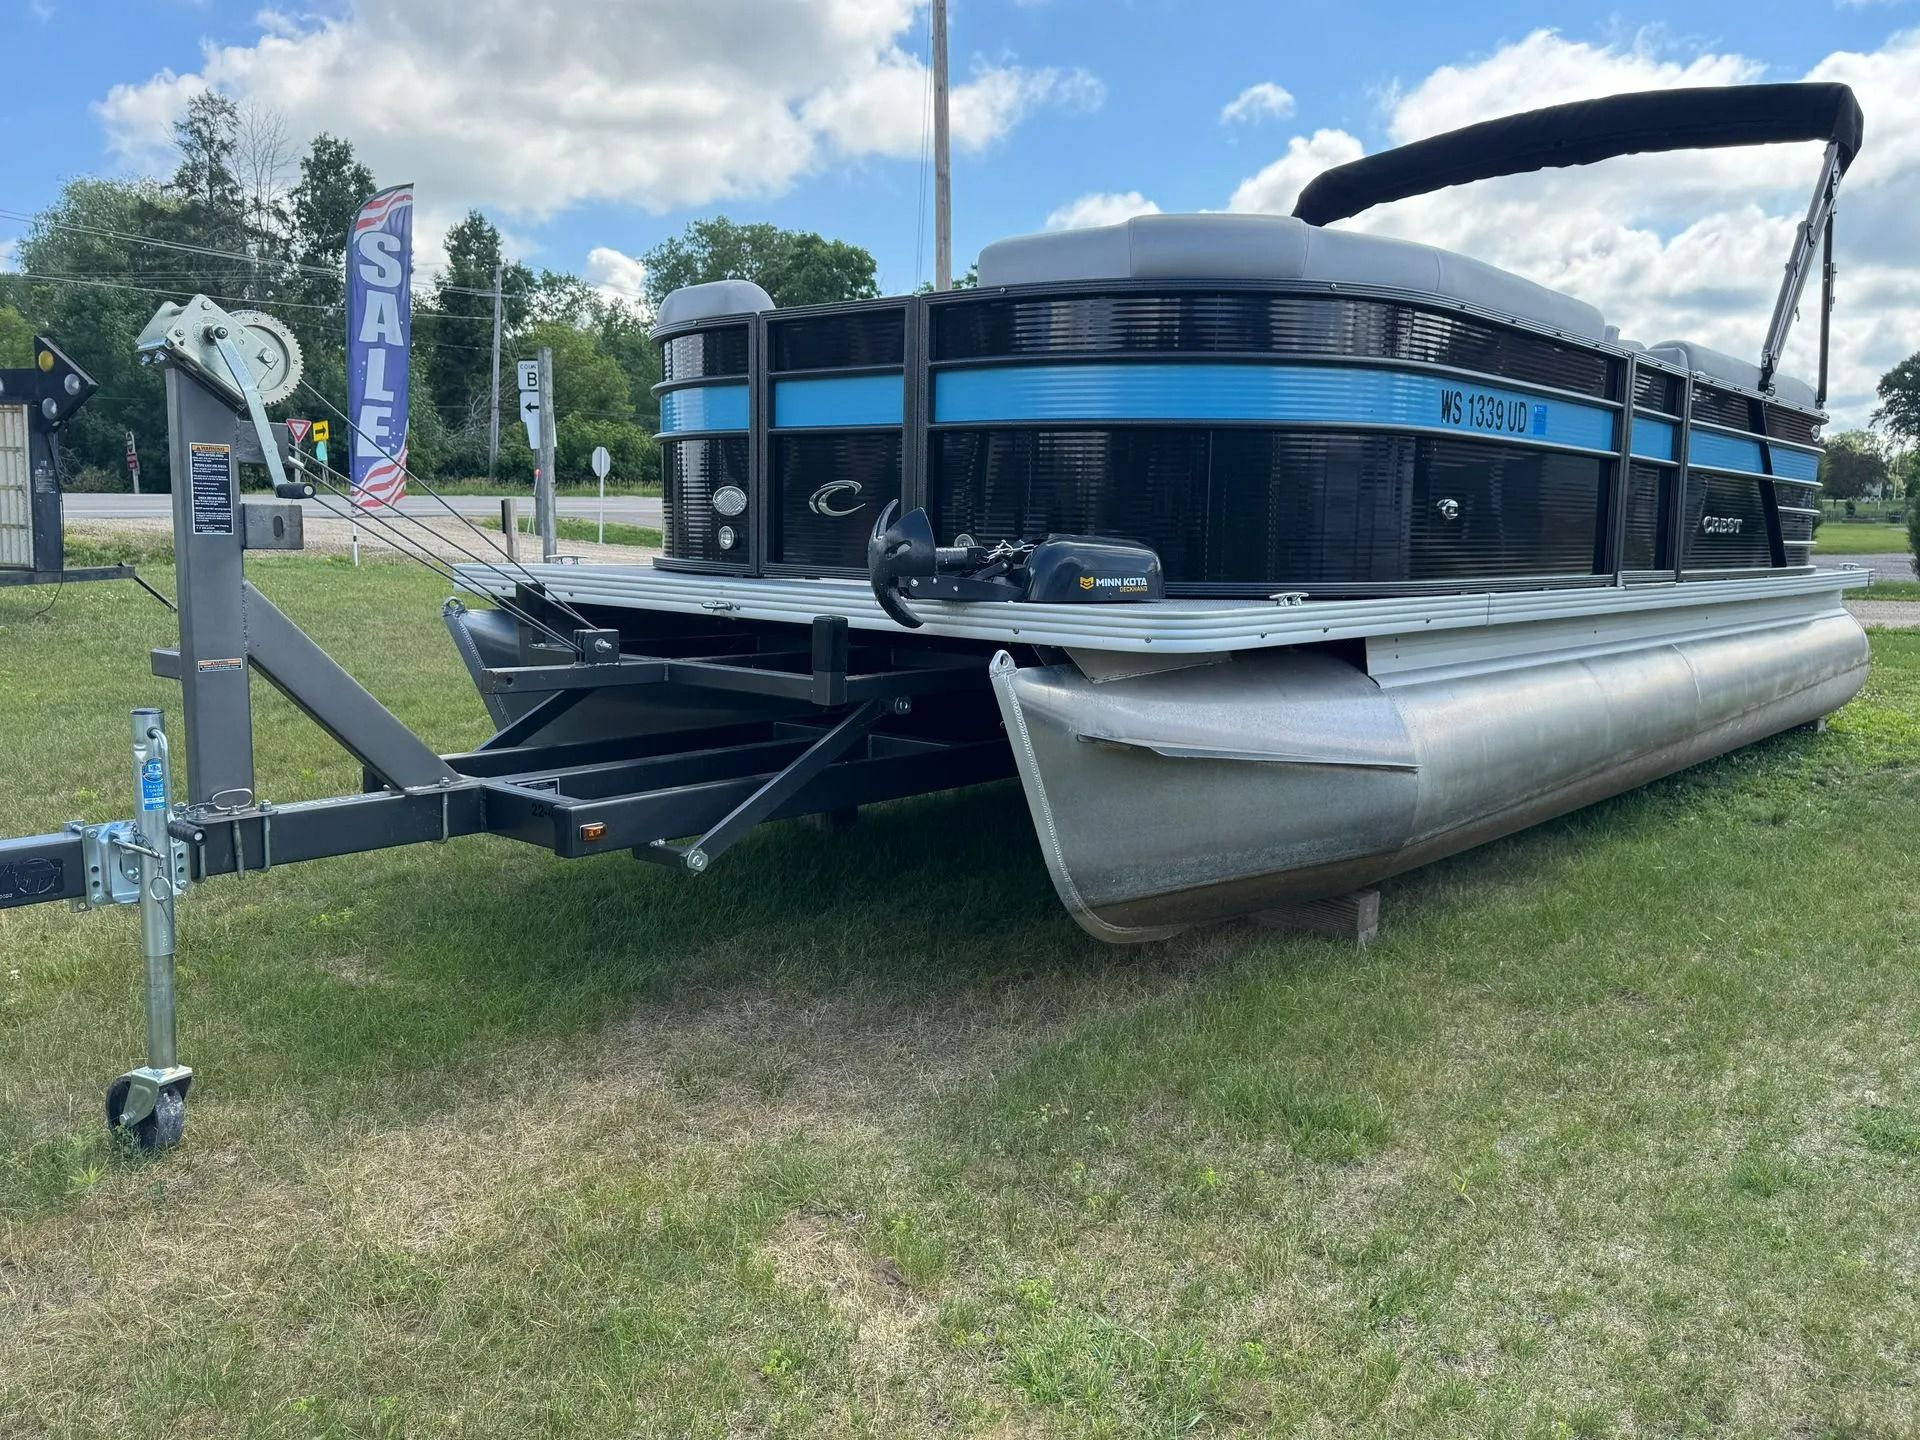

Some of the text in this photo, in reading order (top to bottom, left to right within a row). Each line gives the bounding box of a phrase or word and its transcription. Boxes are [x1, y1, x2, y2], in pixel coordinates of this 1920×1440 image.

[356, 230, 404, 458] SALE
[527, 371, 538, 387] B
[1441, 389, 1463, 425] WS
[1468, 393, 1504, 431] 1339
[1507, 400, 1527, 433] UD
[1703, 515, 1743, 534] CREST
[1096, 577, 1148, 587] MINN KOTA
[1119, 585, 1148, 593] DECKHAND
